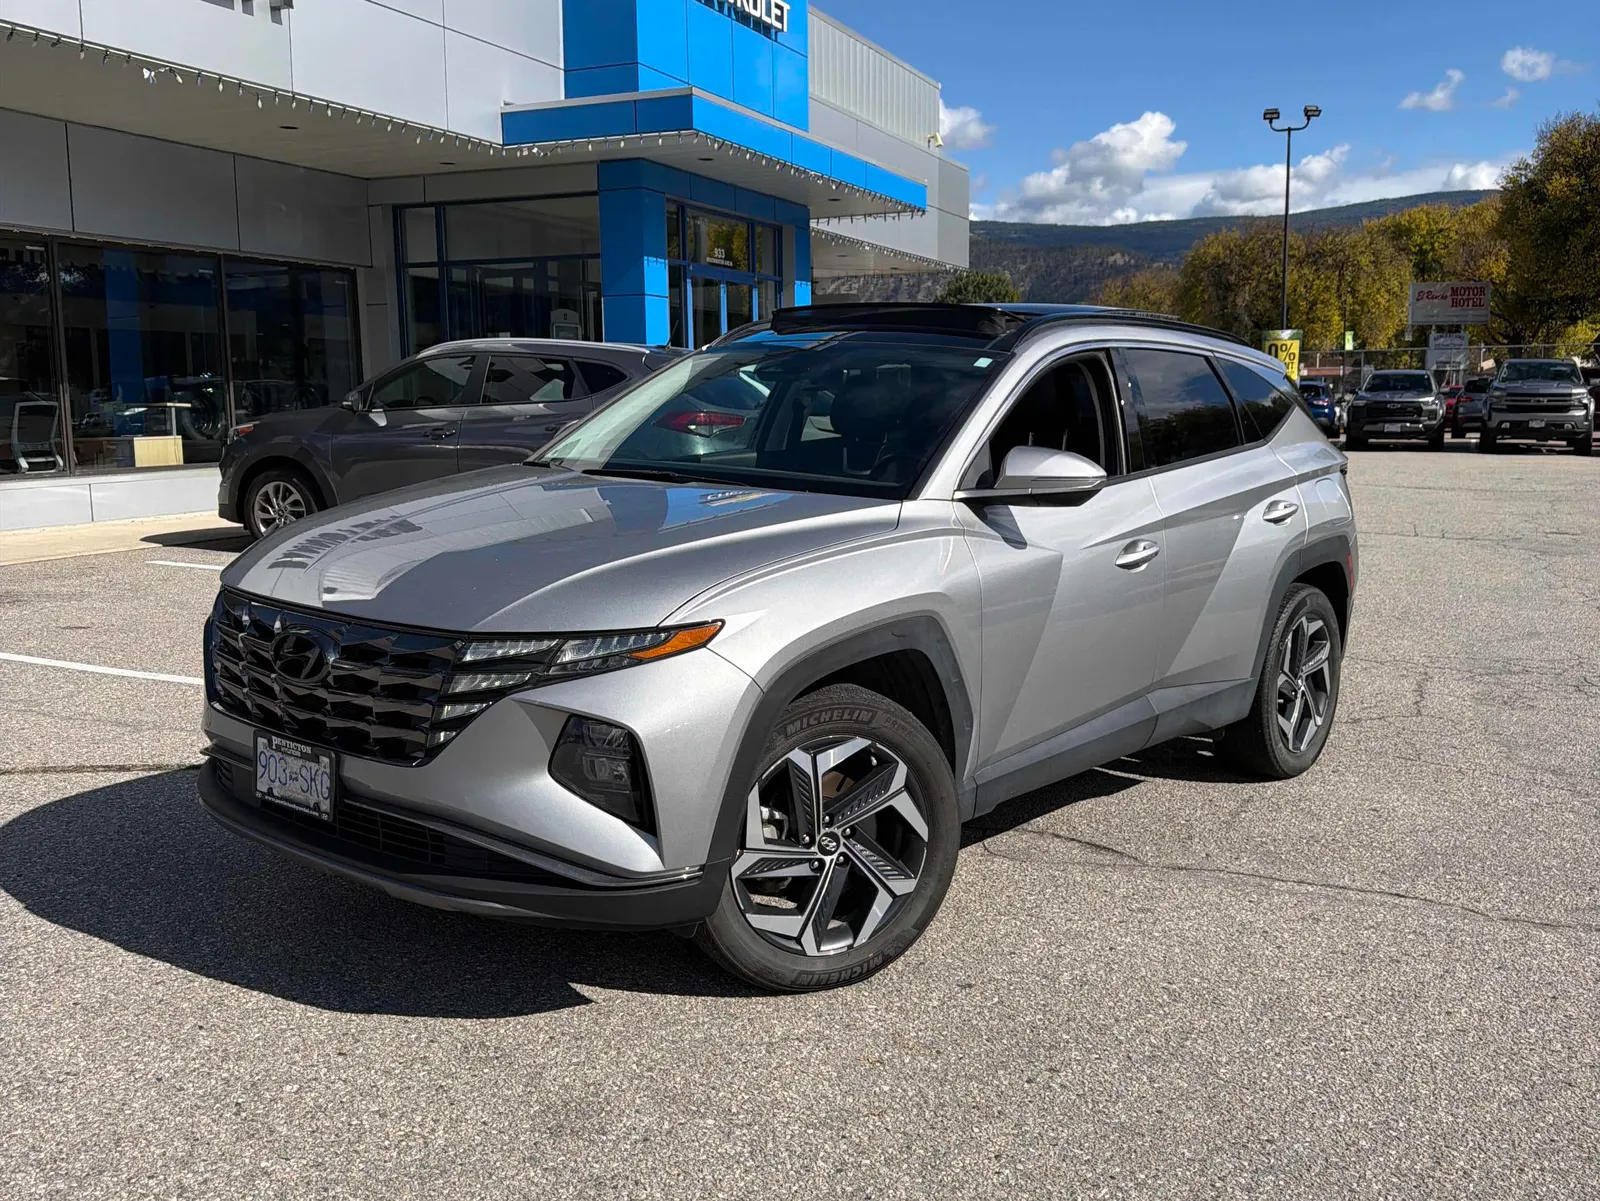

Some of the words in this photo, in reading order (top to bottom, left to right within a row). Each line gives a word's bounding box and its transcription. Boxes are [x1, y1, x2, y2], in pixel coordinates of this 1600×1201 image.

[714, 247, 725, 258] 933
[1450, 286, 1486, 297] MOTOR
[1451, 298, 1484, 308] HOTEL
[786, 709, 873, 735] MICHELIN
[272, 735, 312, 754] PENTICTON
[258, 750, 288, 786] 903
[800, 951, 884, 985] MICHELIN
